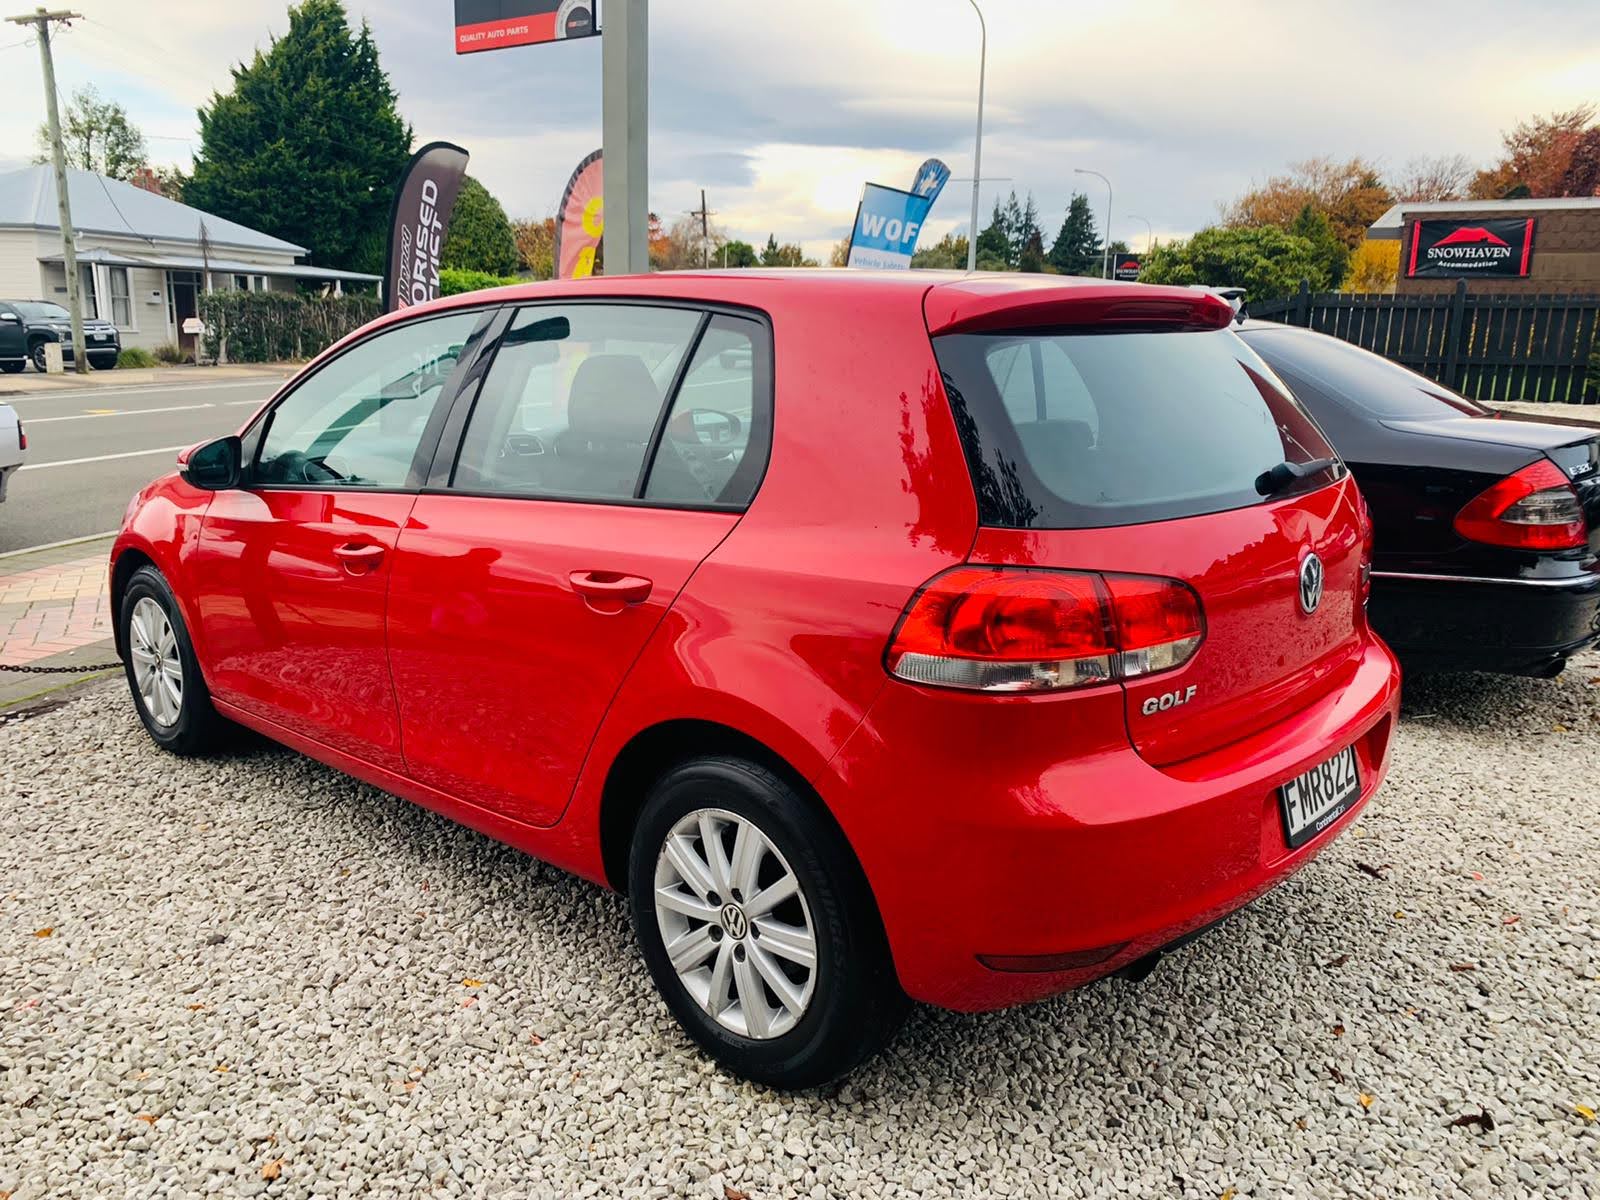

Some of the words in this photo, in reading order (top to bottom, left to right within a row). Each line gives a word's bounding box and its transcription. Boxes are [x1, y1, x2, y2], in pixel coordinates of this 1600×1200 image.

[460, 30, 487, 43] QUALITY
[487, 28, 505, 39] AUTO
[506, 25, 529, 36] PARTS
[862, 212, 919, 244] WOF
[1427, 246, 1512, 259] SNOWHAVEN
[1437, 260, 1498, 268] Accommodation
[1142, 684, 1198, 716] GOLF
[1284, 746, 1355, 829] FMR822
